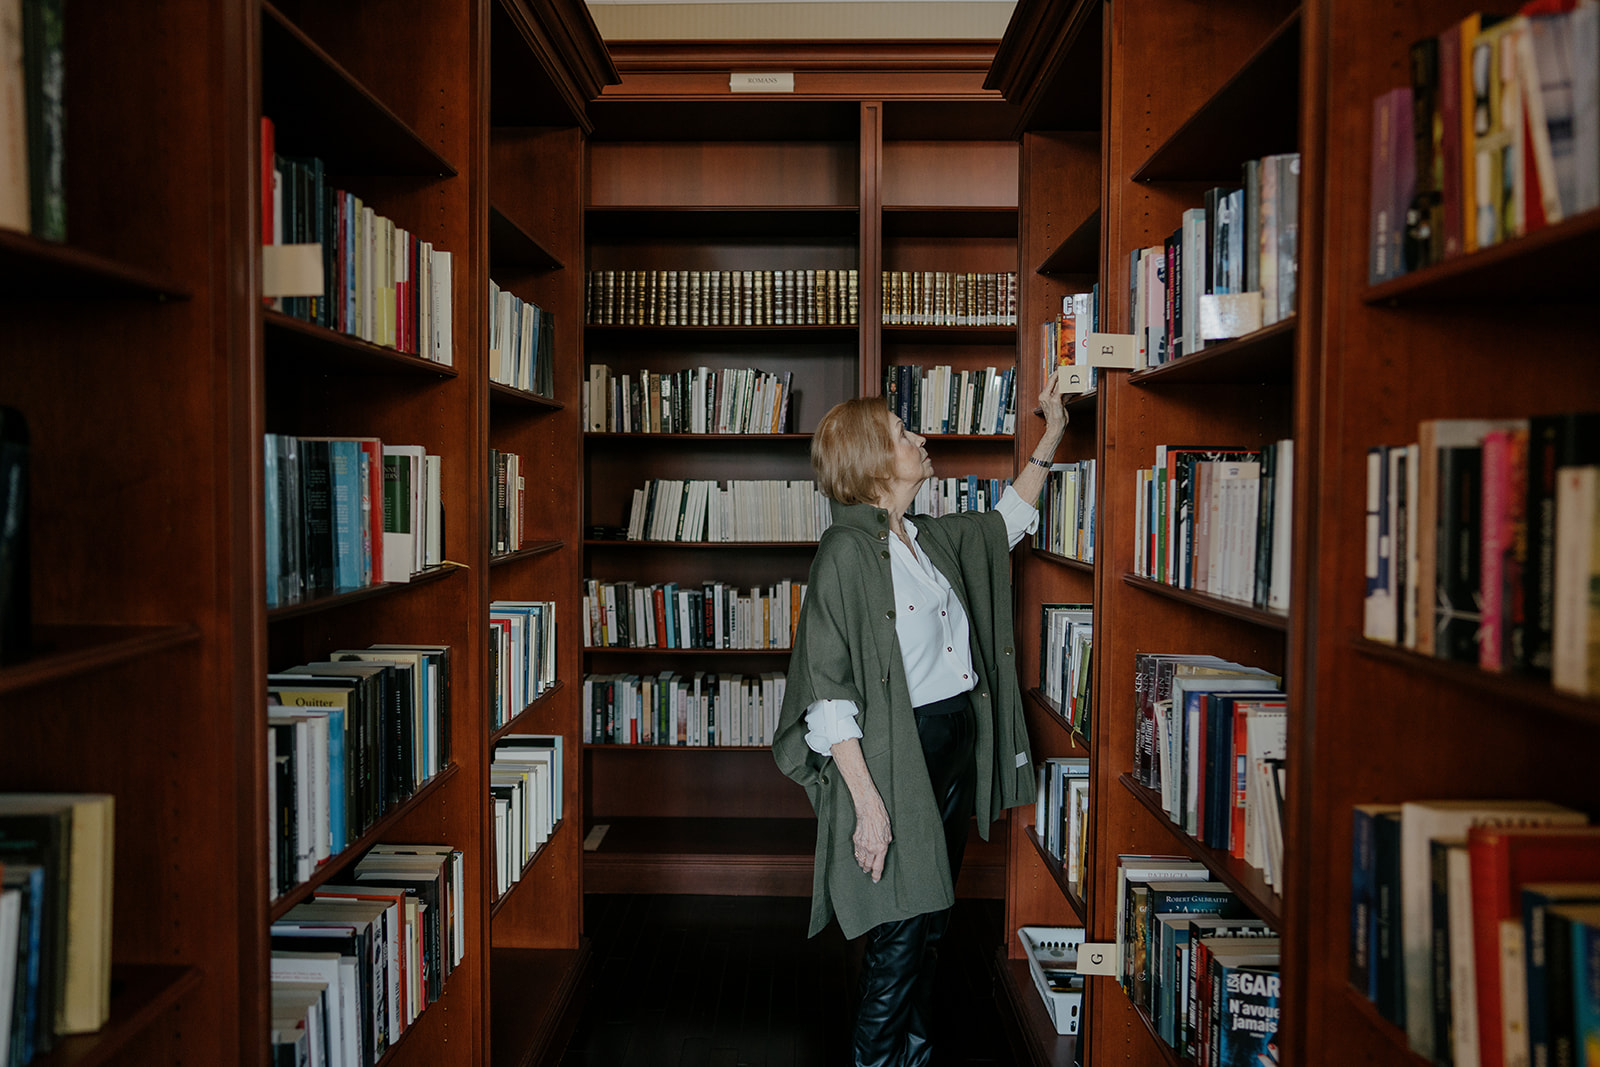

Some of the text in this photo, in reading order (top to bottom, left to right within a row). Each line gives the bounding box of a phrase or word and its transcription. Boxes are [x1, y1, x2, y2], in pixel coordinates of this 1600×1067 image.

[1101, 345, 1114, 356] E
[1069, 374, 1081, 384] D
[295, 697, 334, 708] Quitter
[1165, 895, 1228, 903] ROBERT GALBRAITH
[1090, 953, 1104, 965] G
[1231, 1014, 1279, 1034] jamais
